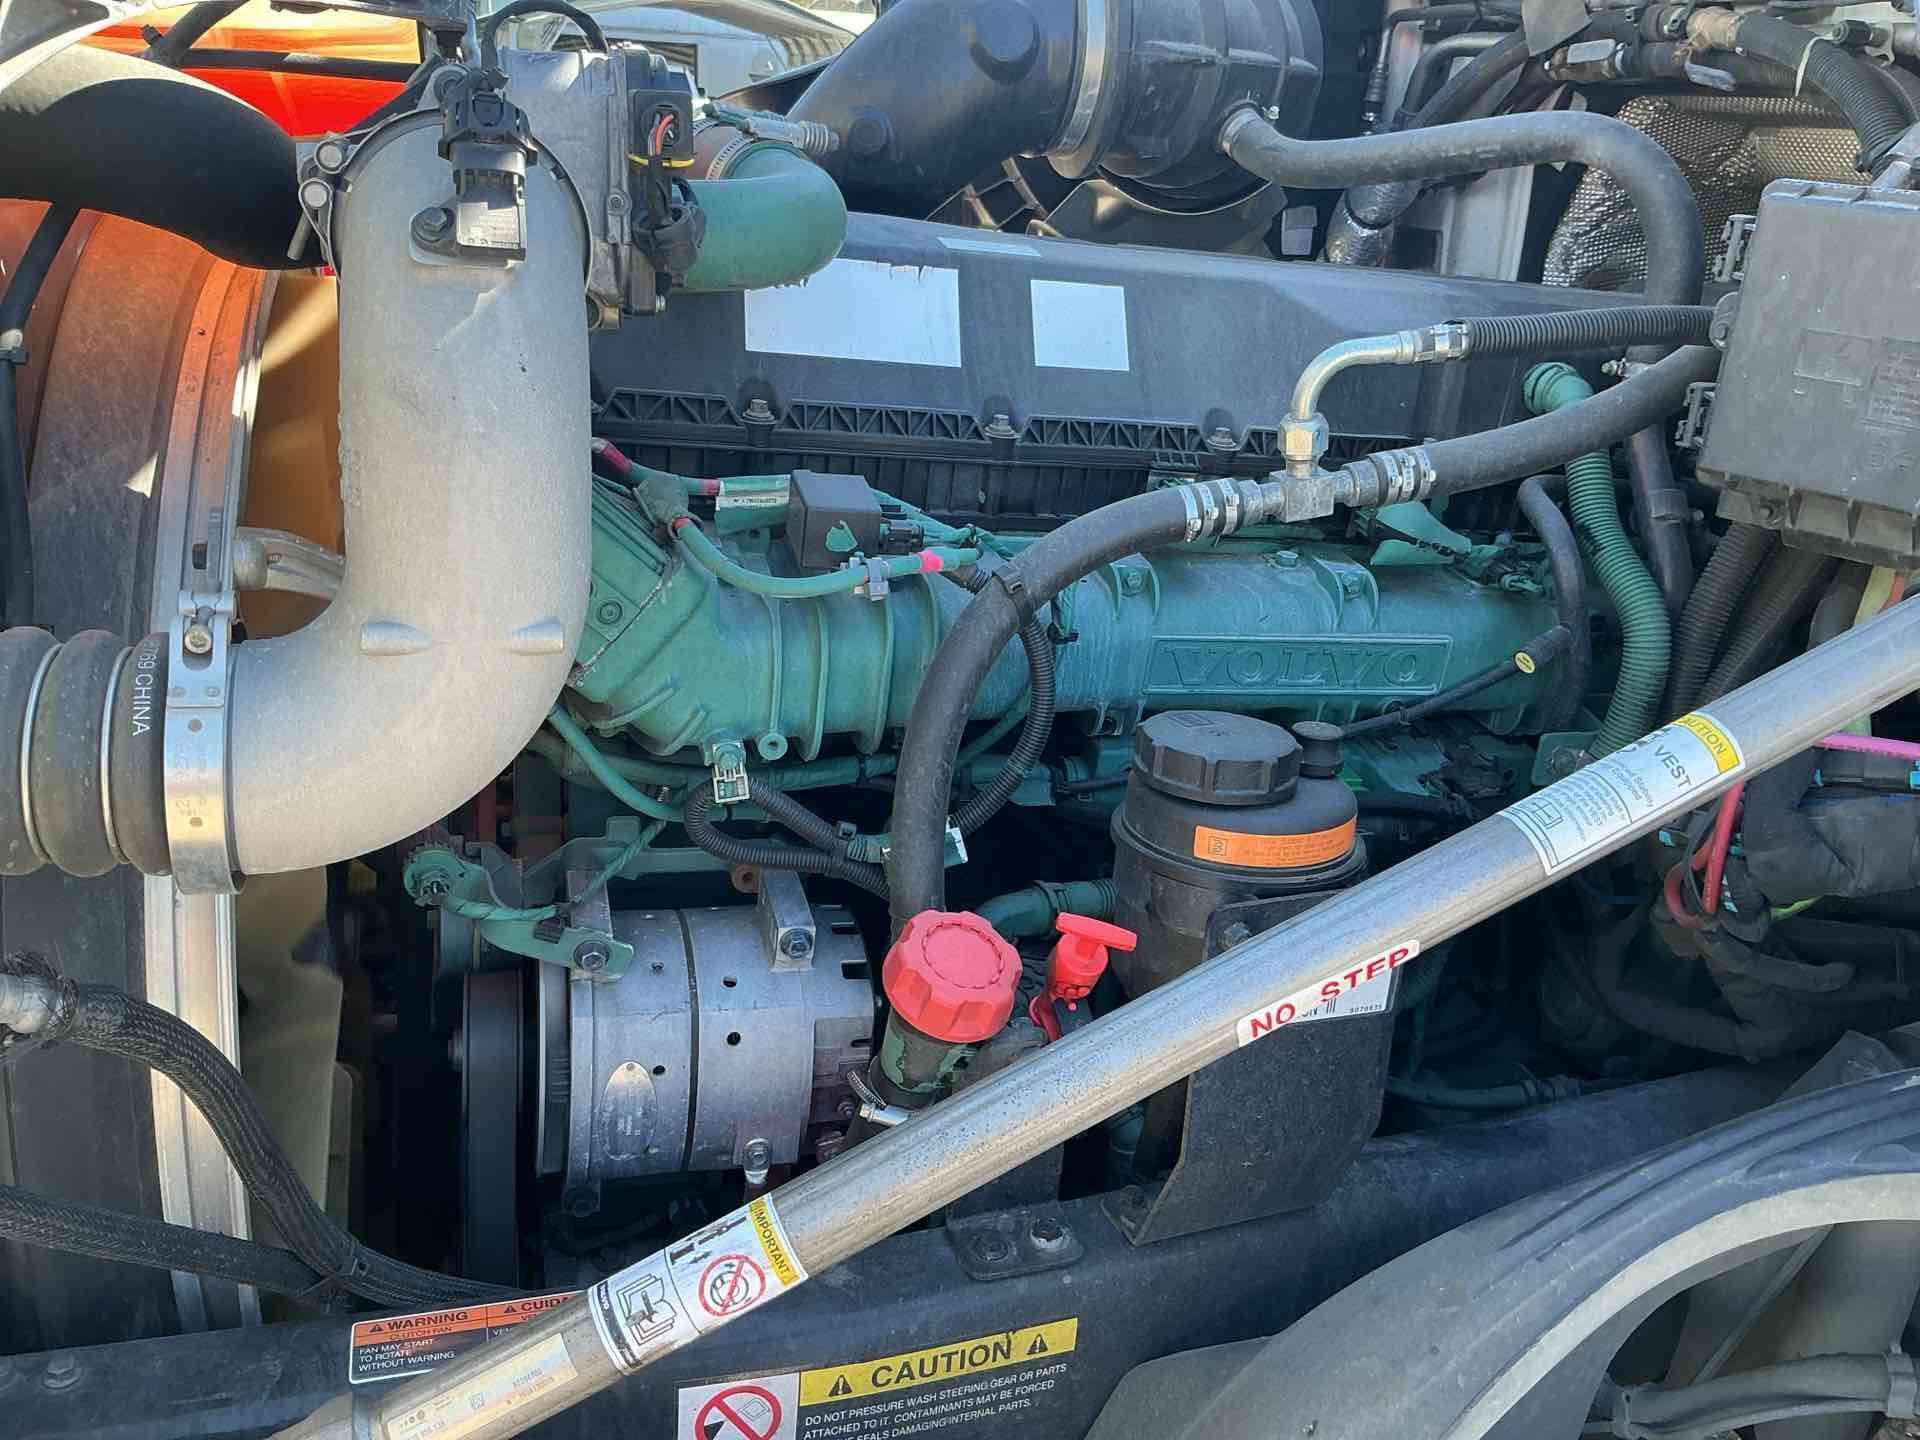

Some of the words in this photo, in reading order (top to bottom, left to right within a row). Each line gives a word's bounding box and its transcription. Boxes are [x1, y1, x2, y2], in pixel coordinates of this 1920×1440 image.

[1161, 648, 1418, 688] VOLVO
[131, 673, 154, 737] CHINA
[1679, 716, 1728, 755] AUTION
[1653, 744, 1693, 789] VEST
[1250, 1003, 1296, 1039] NO
[1320, 947, 1409, 1002] STEP
[753, 1208, 790, 1274] IMPORTANT
[387, 1311, 468, 1330] WARNING
[390, 1329, 432, 1340] CLUTCH
[432, 1326, 453, 1335] FAN
[358, 1358, 405, 1372] WITHOUT
[359, 1346, 379, 1355] FAN
[381, 1343, 401, 1352] MAY
[401, 1338, 434, 1349] START
[359, 1354, 373, 1363] TO
[375, 1349, 412, 1361] ROTATE
[871, 1336, 1012, 1388] CAUTION
[804, 1422, 861, 1440] ATTACHED
[862, 1419, 877, 1429] TO
[879, 1415, 891, 1426] IT.
[894, 1398, 974, 1424] CONTAMINANTS
[975, 1392, 998, 1406] MAY
[999, 1387, 1013, 1400] BE
[1015, 1379, 1055, 1396] FORCED
[805, 1415, 822, 1426] DO
[823, 1410, 847, 1423] NOT
[848, 1399, 905, 1419] PRESSURE
[906, 1392, 937, 1408] WASH
[939, 1381, 988, 1400] STEERING
[990, 1374, 1017, 1388] GEAR
[1019, 1369, 1034, 1381] OR
[1035, 1363, 1067, 1377] PARTS
[856, 1430, 889, 1440] SEALS
[891, 1417, 946, 1438] DAMAGING
[949, 1407, 997, 1425] INTERNAL
